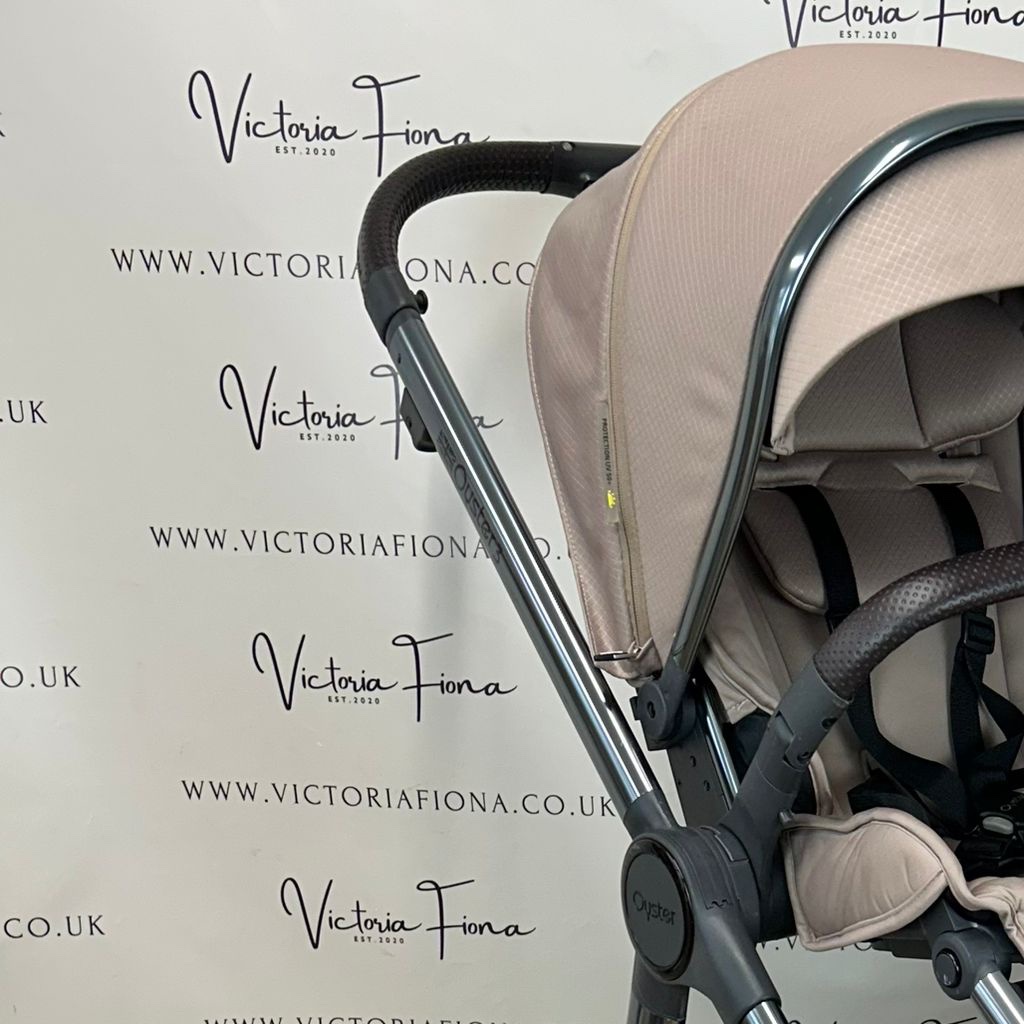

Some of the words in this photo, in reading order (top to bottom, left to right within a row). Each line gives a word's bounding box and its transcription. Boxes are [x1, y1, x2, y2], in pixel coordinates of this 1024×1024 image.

[839, 30, 898, 40] EST.2020
[188, 70, 358, 164] Victoria
[352, 74, 490, 178] Fiona
[275, 146, 336, 156] EST.2020
[219, 364, 376, 450] Victoria
[300, 433, 356, 442] EST.2020
[252, 632, 398, 711] Victoria
[392, 633, 518, 723] Fiona
[328, 696, 380, 704] EST.2020
[181, 780, 616, 817] WWW.VICTORIAFIONA.CO.UK
[280, 877, 422, 950] Victoria
[416, 879, 537, 960] Fiona
[632, 890, 676, 926] Oyster
[354, 936, 405, 944] EST.2020
